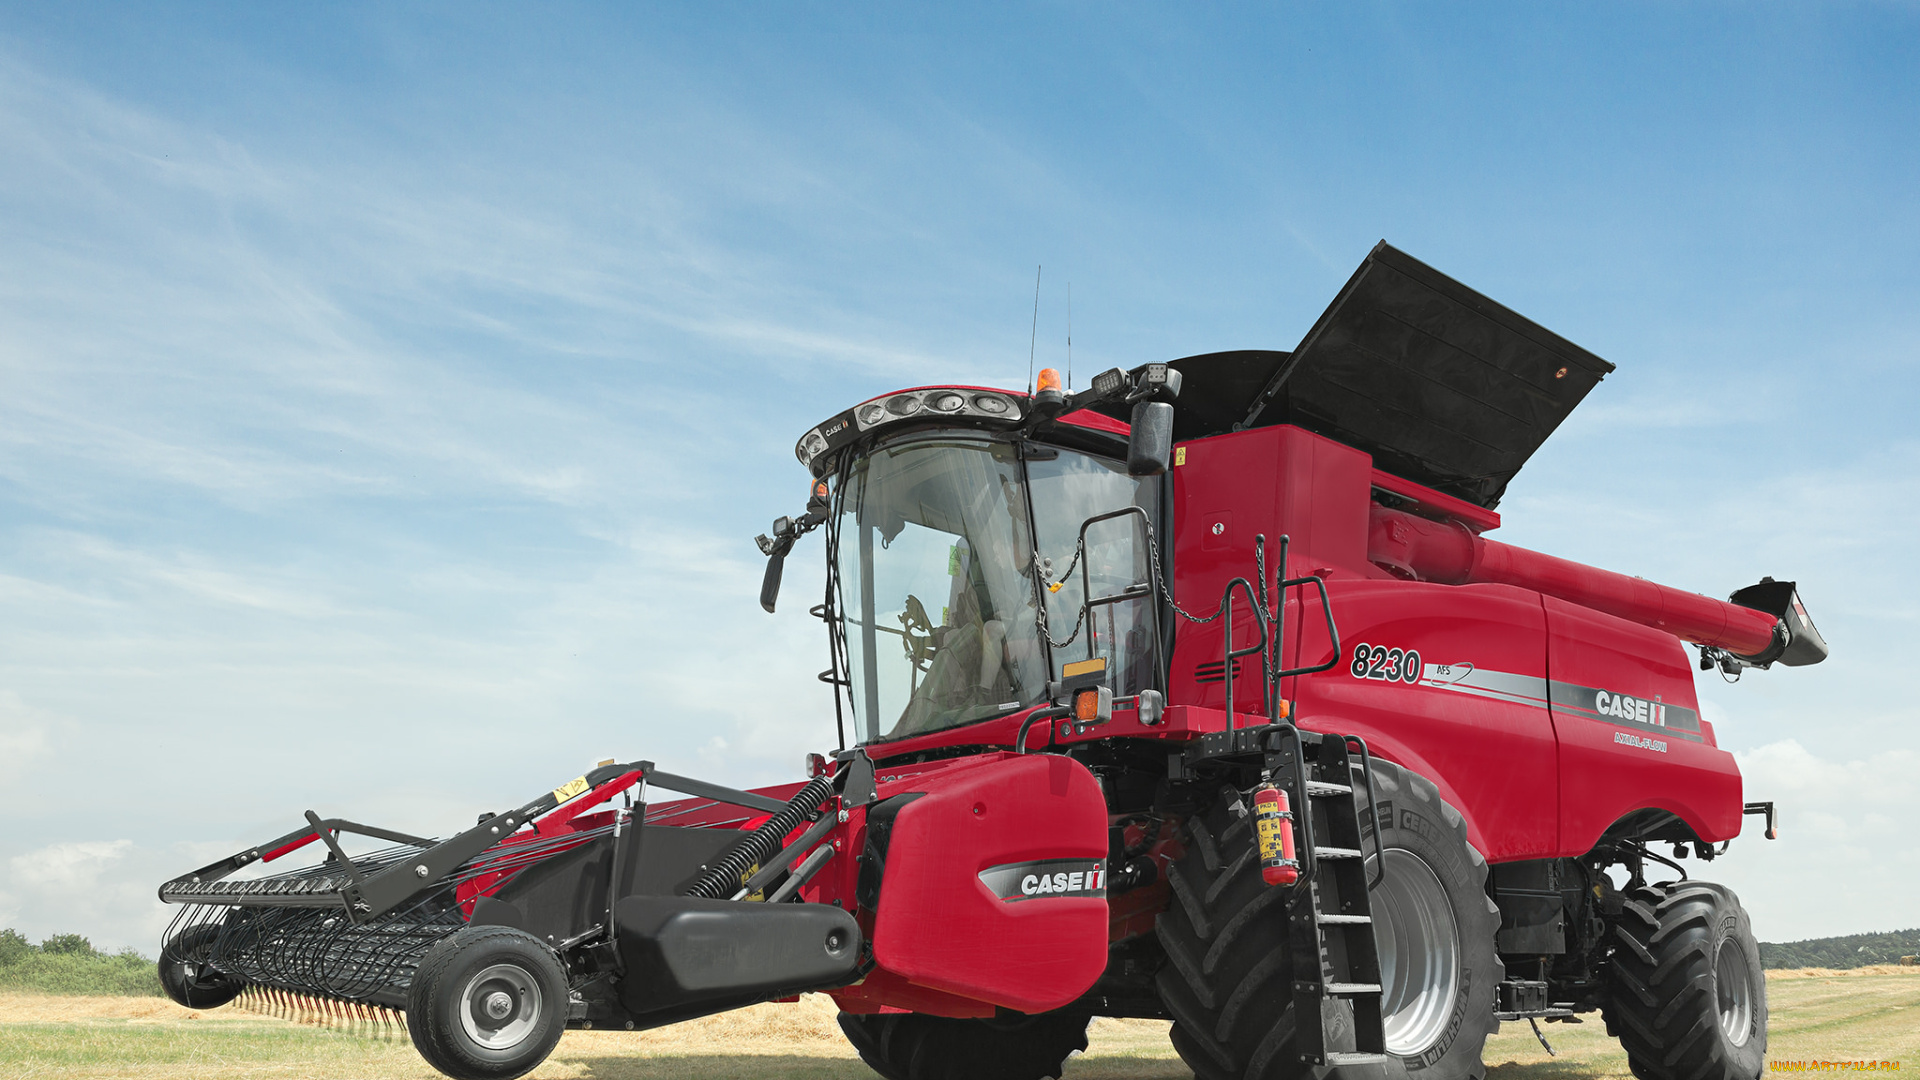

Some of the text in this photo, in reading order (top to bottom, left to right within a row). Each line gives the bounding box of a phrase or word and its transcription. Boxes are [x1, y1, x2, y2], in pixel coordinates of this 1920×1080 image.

[826, 423, 842, 437] CASE
[1351, 643, 1420, 684] 8230
[1437, 664, 1451, 675] AFS
[1595, 690, 1648, 723] CASE
[1614, 732, 1667, 753] AXIAL-FLOW
[1021, 872, 1084, 896] CASE
